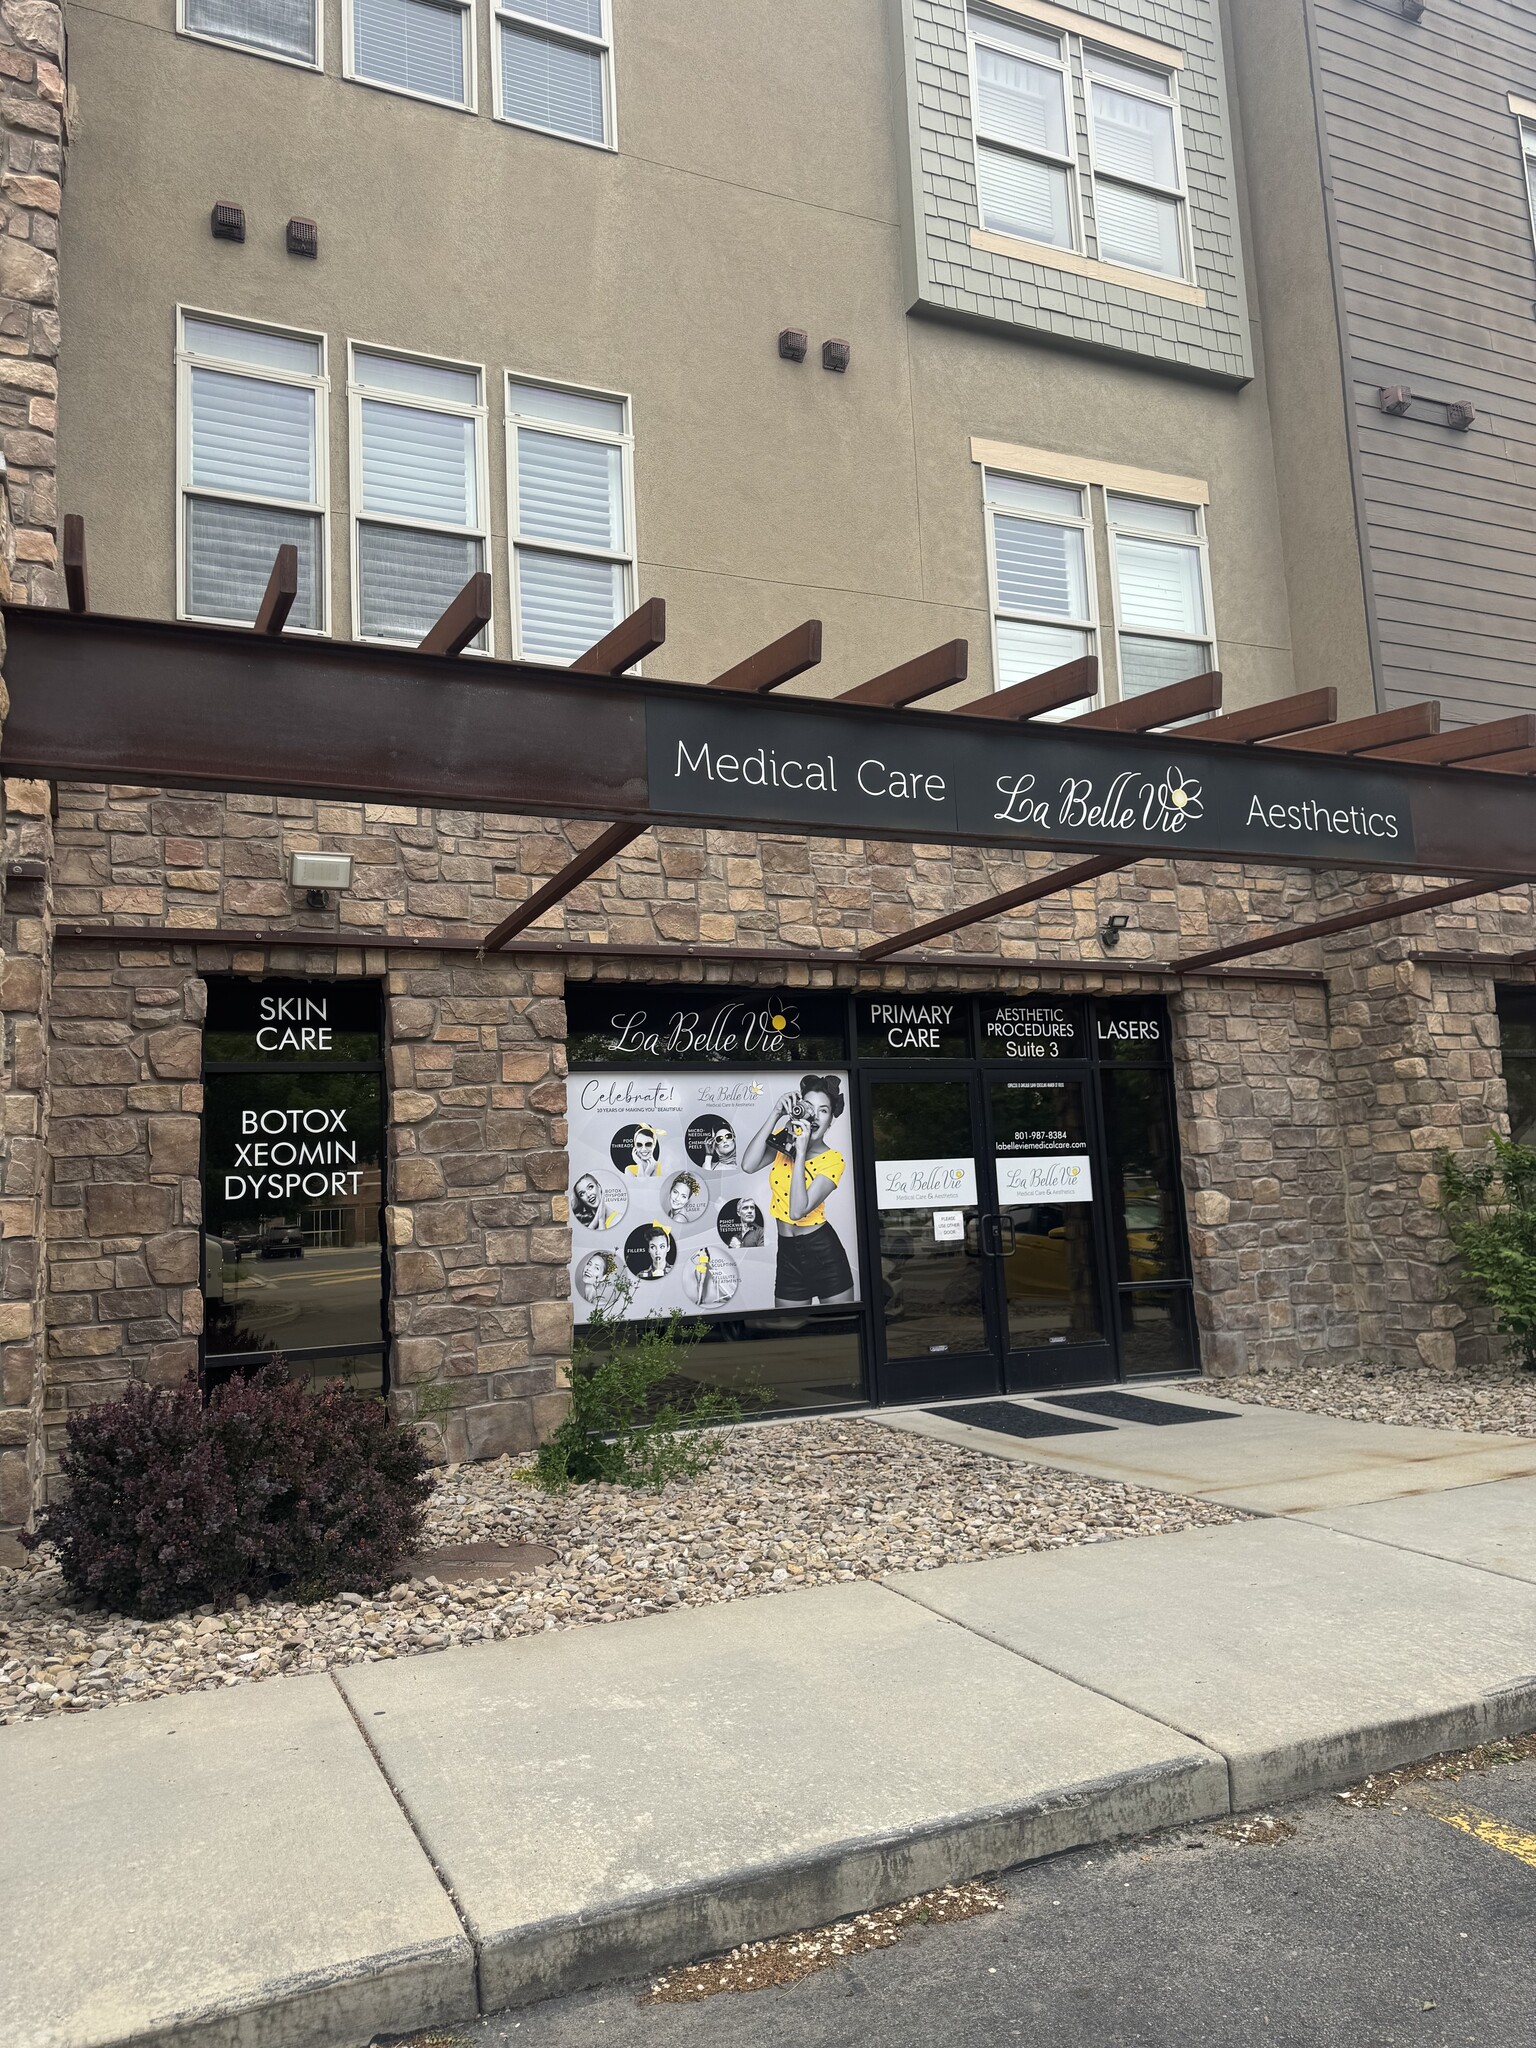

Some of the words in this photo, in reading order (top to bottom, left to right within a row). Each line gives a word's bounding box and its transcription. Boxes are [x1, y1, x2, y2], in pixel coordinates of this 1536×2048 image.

[674, 740, 837, 792] Medical
[857, 759, 946, 801] Care
[994, 774, 1051, 829] La
[1058, 771, 1142, 829] Belle
[1139, 783, 1188, 833] Vie
[1246, 794, 1398, 838] Aesthetics
[259, 997, 327, 1021] SKIN
[871, 1004, 954, 1025] PRIMARY
[995, 1007, 1064, 1022] AESTHETIC
[256, 1026, 332, 1051] CARE
[608, 1010, 660, 1056] La
[667, 1003, 745, 1052] Belle
[741, 1011, 785, 1052] Vie
[887, 1028, 940, 1048] CARE
[987, 1023, 1074, 1037] PROCEDURES
[1097, 1020, 1160, 1040] LASERS
[1006, 1041, 1045, 1058] Suite
[1049, 1041, 1059, 1058] 3
[581, 1079, 674, 1111] Celebrate!
[698, 1086, 715, 1102] La
[717, 1082, 742, 1101] Belle
[742, 1085, 759, 1101] Vie
[242, 1109, 347, 1134] BOTOX
[995, 1141, 1087, 1150] labelleviemedicalcare.com
[1014, 1131, 1067, 1140] 801-987-8384
[234, 1140, 356, 1167] XEOMIN
[225, 1171, 363, 1200] DYSPORT
[885, 1172, 907, 1193] La
[910, 1166, 943, 1191] Belle
[942, 1169, 962, 1189] Vie
[1006, 1169, 1027, 1189] La
[1030, 1163, 1061, 1187] Belle
[1059, 1166, 1078, 1185] Vie
